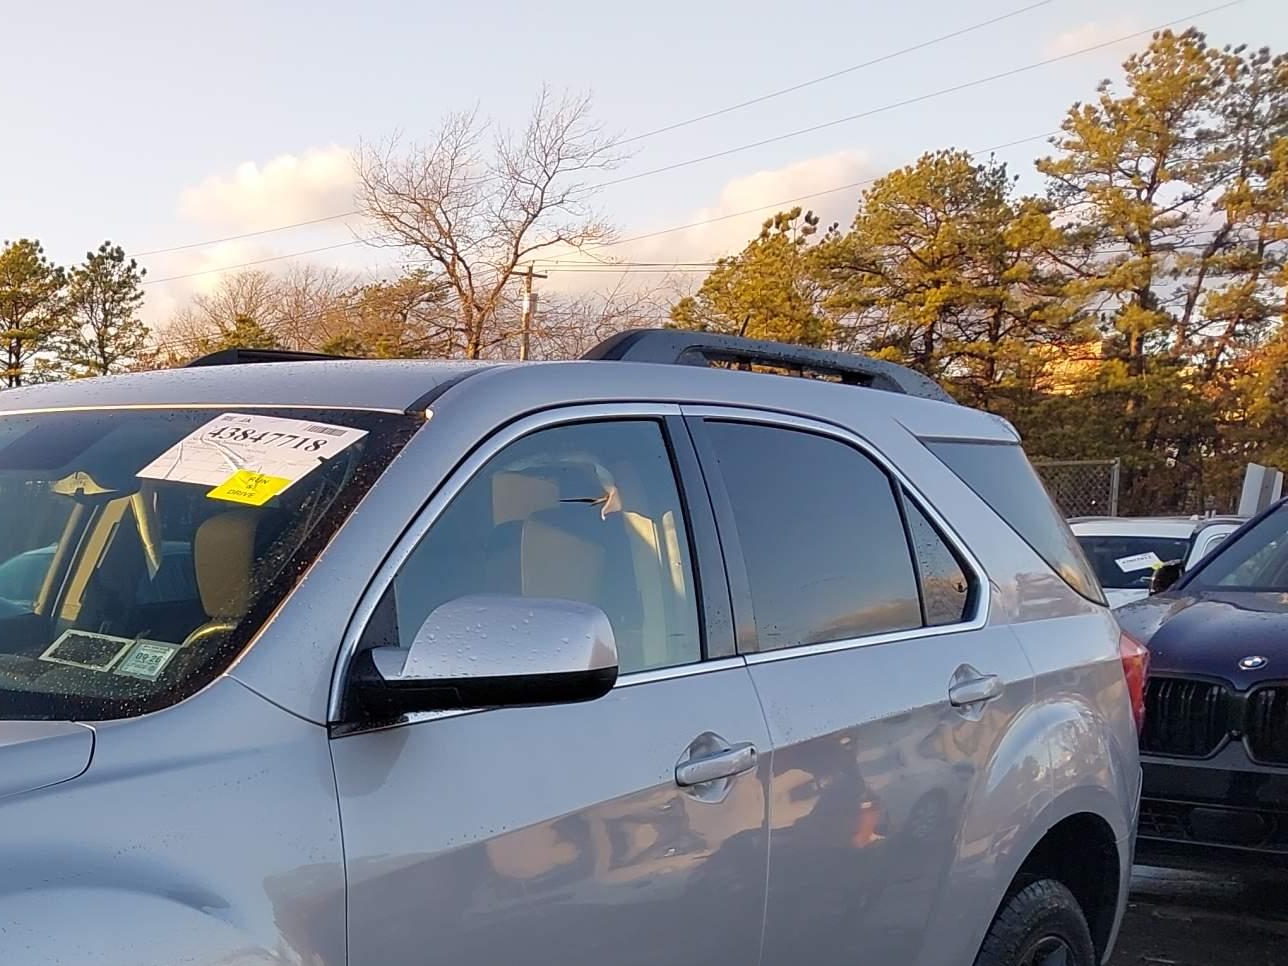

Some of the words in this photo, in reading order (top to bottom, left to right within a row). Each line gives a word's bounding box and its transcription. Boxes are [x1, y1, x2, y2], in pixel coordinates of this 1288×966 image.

[207, 426, 328, 452] 43847718
[247, 474, 271, 485] RUN
[226, 488, 256, 498] DRIVE
